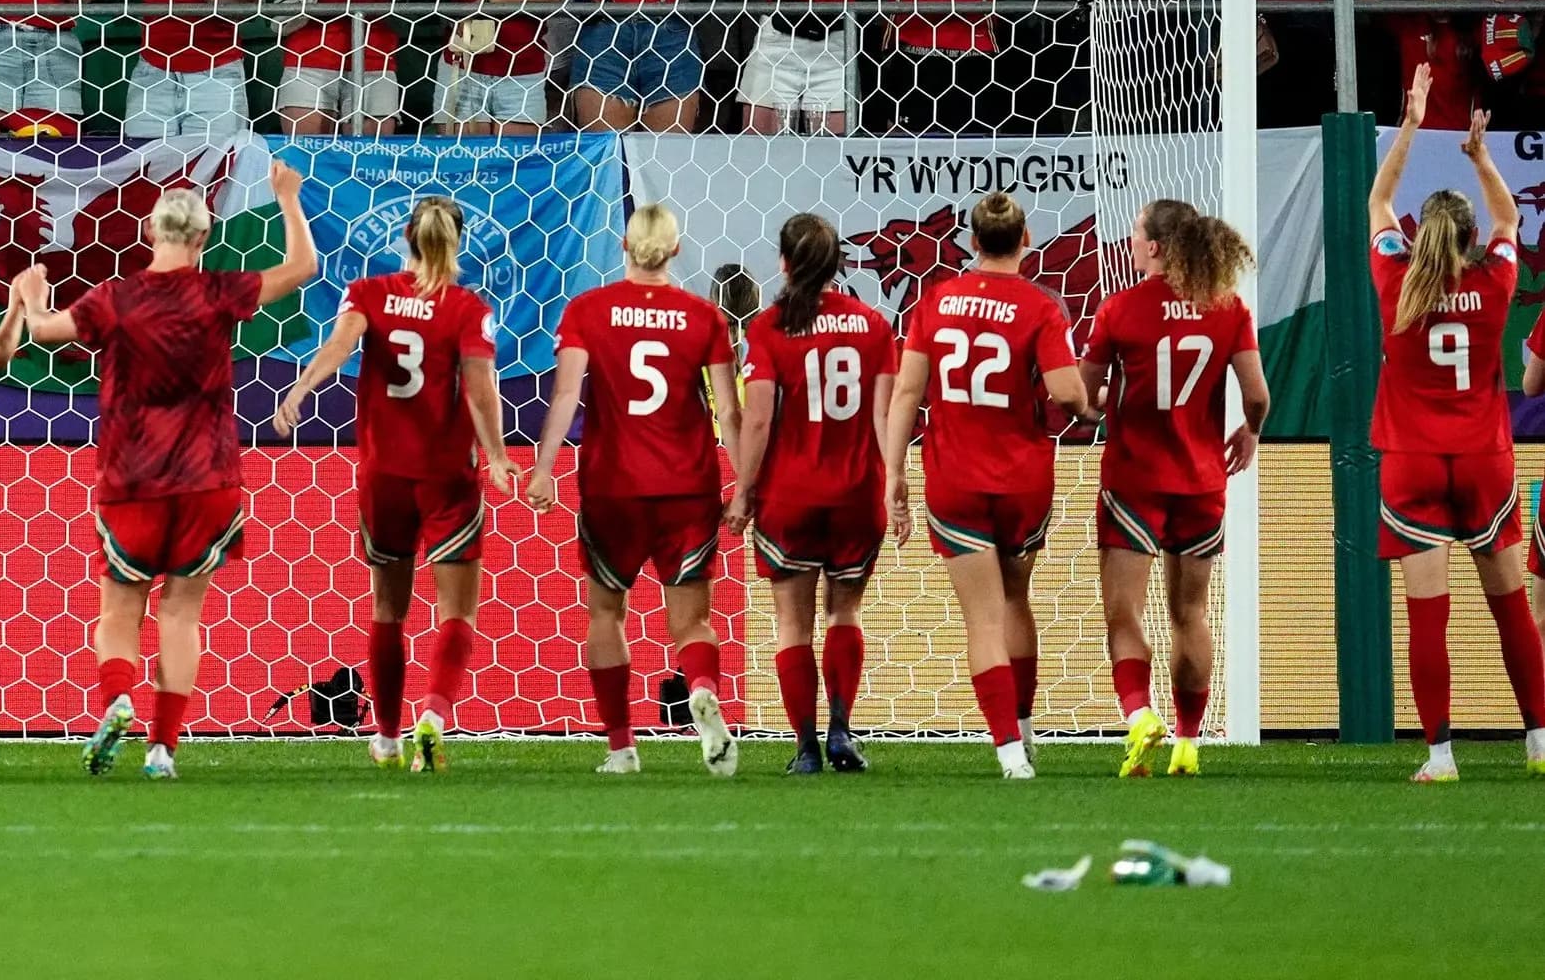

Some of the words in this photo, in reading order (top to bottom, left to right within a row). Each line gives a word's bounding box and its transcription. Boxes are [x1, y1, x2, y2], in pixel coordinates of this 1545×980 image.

[413, 146, 432, 158] FA
[435, 145, 511, 159] WOMENS
[514, 139, 575, 158] LEAGUE
[355, 167, 450, 186] CHAMPIONS
[845, 154, 897, 194] YR
[907, 151, 1129, 194] WYDDGRUG
[383, 294, 435, 321] EVANS
[610, 306, 687, 331] ROBERTS
[938, 295, 1017, 323] GRIFFITHS
[1161, 300, 1203, 321] JOEL
[387, 329, 425, 399] 3
[628, 340, 670, 416] 5
[934, 327, 1011, 408] 22
[1157, 335, 1213, 410] 17
[1429, 323, 1470, 391] 9
[804, 346, 861, 422] 18
